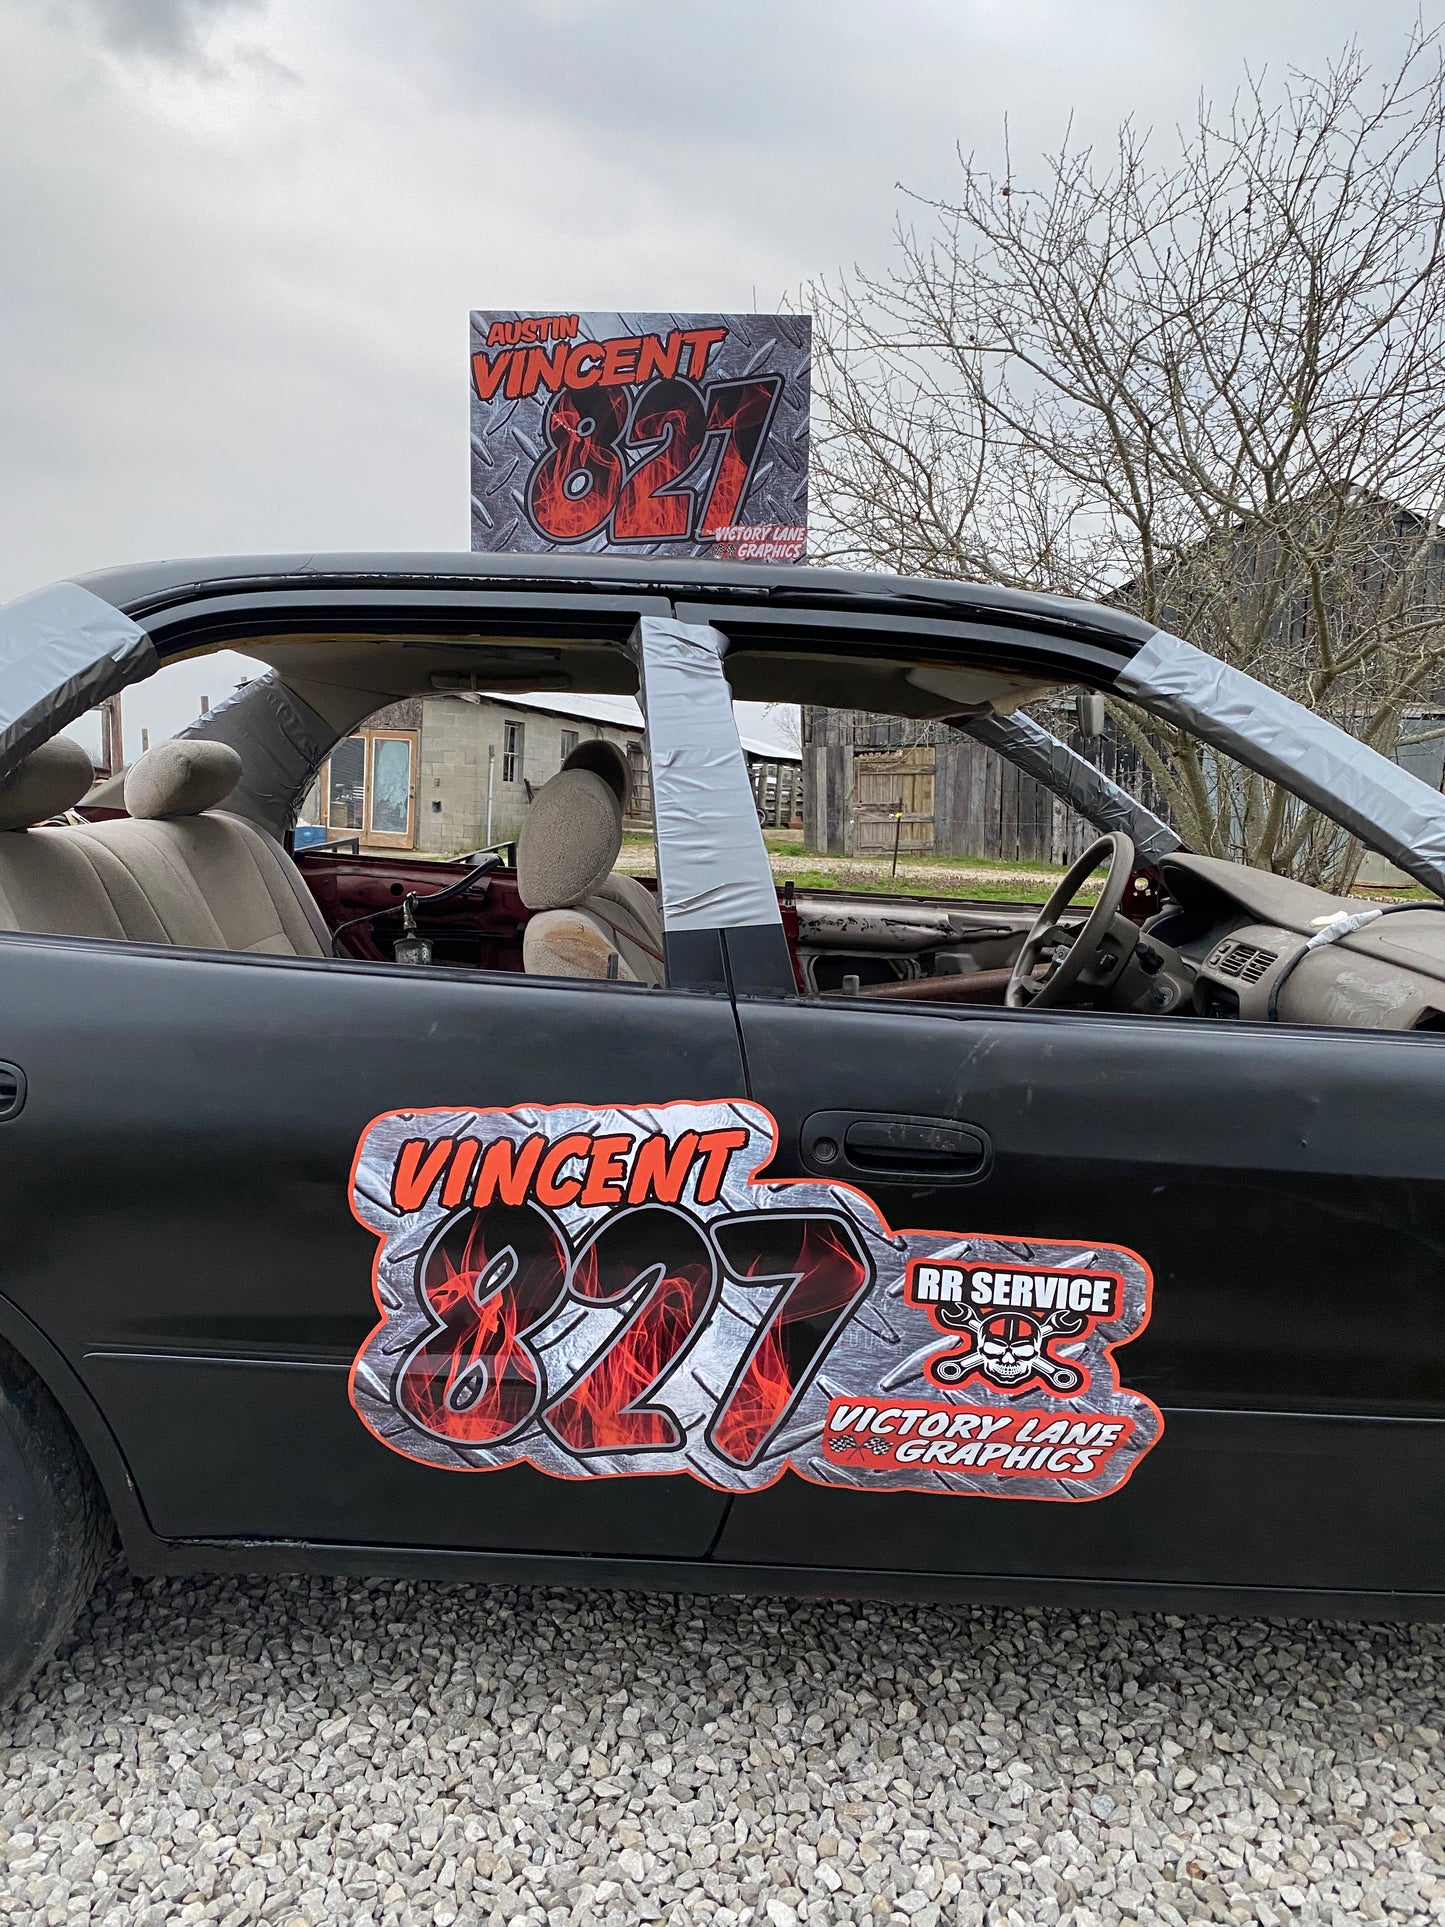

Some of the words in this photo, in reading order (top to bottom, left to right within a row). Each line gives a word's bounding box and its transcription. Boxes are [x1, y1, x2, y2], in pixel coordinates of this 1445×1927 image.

[487, 314, 580, 346] AUSTIN
[471, 326, 729, 400] VINCENT
[524, 372, 786, 546] 827
[714, 525, 771, 542] VICTORY
[771, 526, 807, 542] LANE
[737, 542, 804, 559] GRAPHICS
[390, 1127, 750, 1213] VINCENT
[917, 1267, 965, 1302] RR
[970, 1270, 1112, 1314] SERVICE
[389, 1201, 877, 1471] 827
[829, 1404, 1014, 1441] VICTORY
[1014, 1418, 1125, 1448] LANE
[894, 1439, 1104, 1474] GRAPHICS
